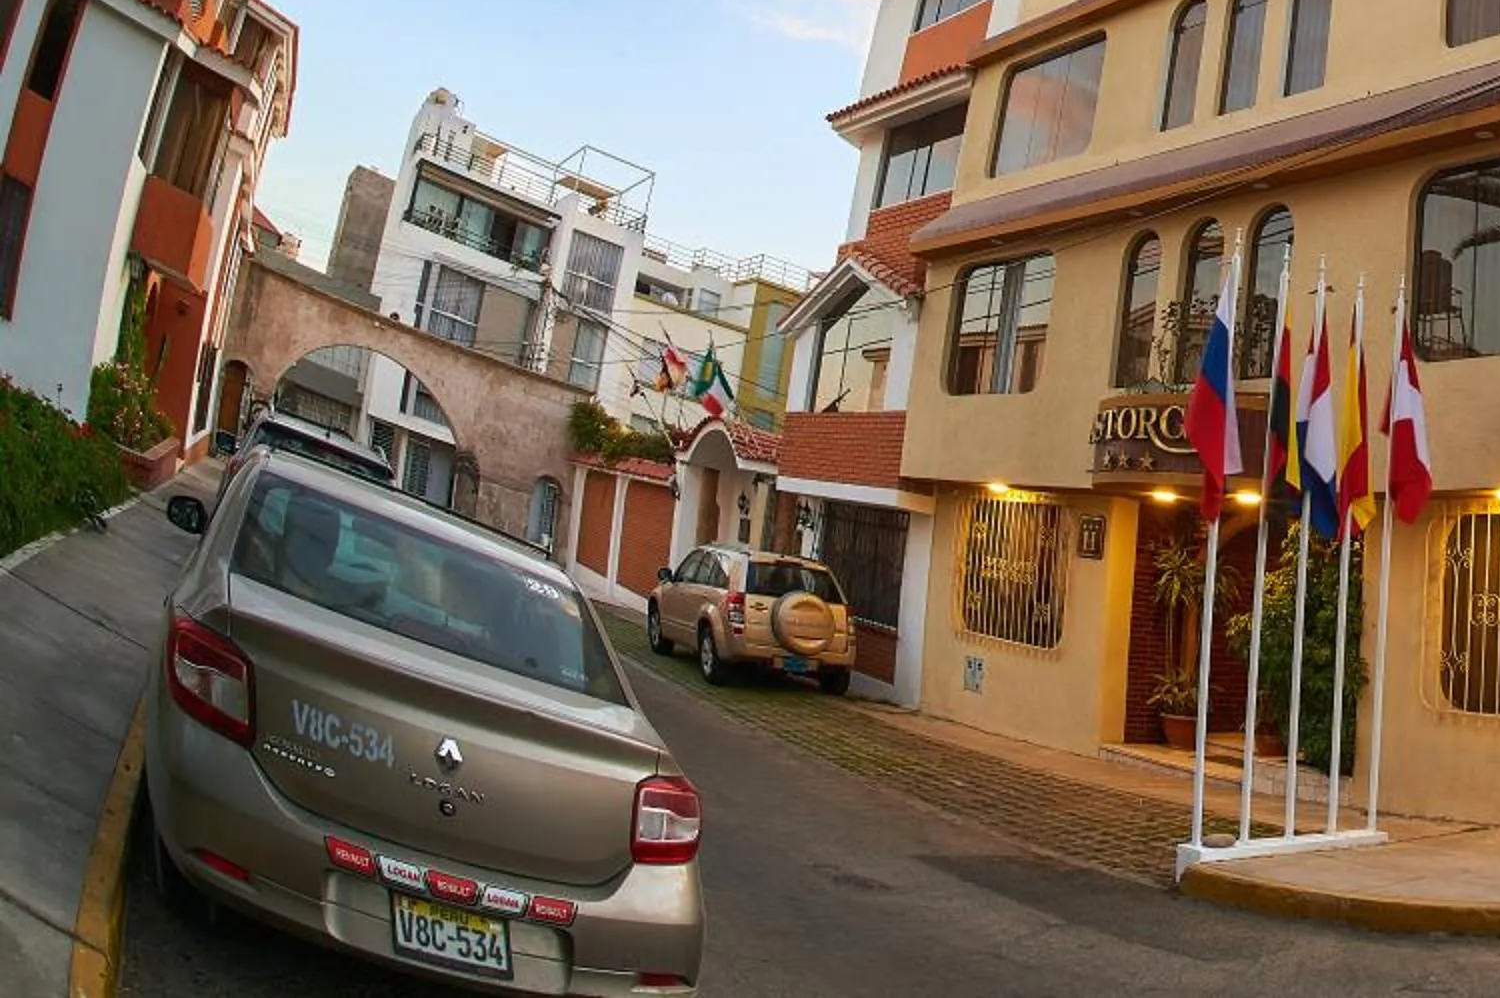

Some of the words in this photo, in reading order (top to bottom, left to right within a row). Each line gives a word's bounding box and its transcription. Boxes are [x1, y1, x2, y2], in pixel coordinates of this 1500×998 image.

[291, 698, 396, 769] V8C-534
[408, 768, 486, 805] LOGAN
[387, 863, 421, 881] LOGAN
[398, 907, 504, 967] V8C-534
